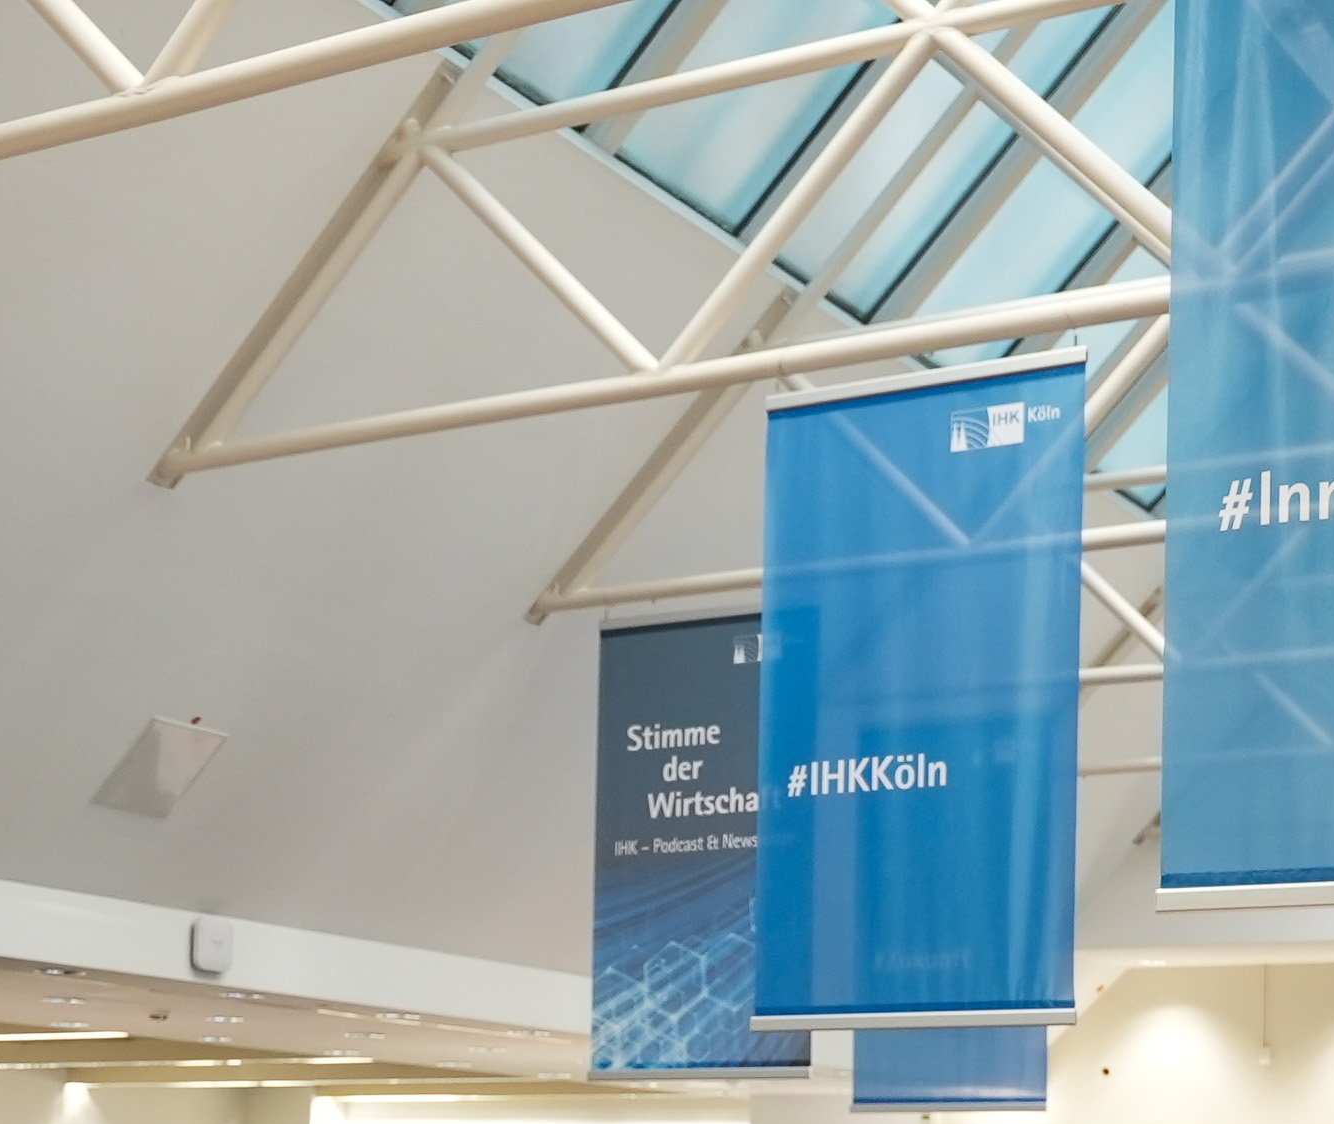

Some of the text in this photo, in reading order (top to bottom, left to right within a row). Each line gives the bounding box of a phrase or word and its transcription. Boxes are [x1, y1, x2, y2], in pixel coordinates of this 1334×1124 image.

[991, 404, 1061, 427] IHK Köln
[626, 723, 721, 752] Stimme
[662, 755, 704, 782] der
[787, 752, 947, 798] #IHKKöln
[647, 786, 760, 819] Wirtscha
[614, 839, 639, 858] IHK
[652, 836, 705, 854] Podcast
